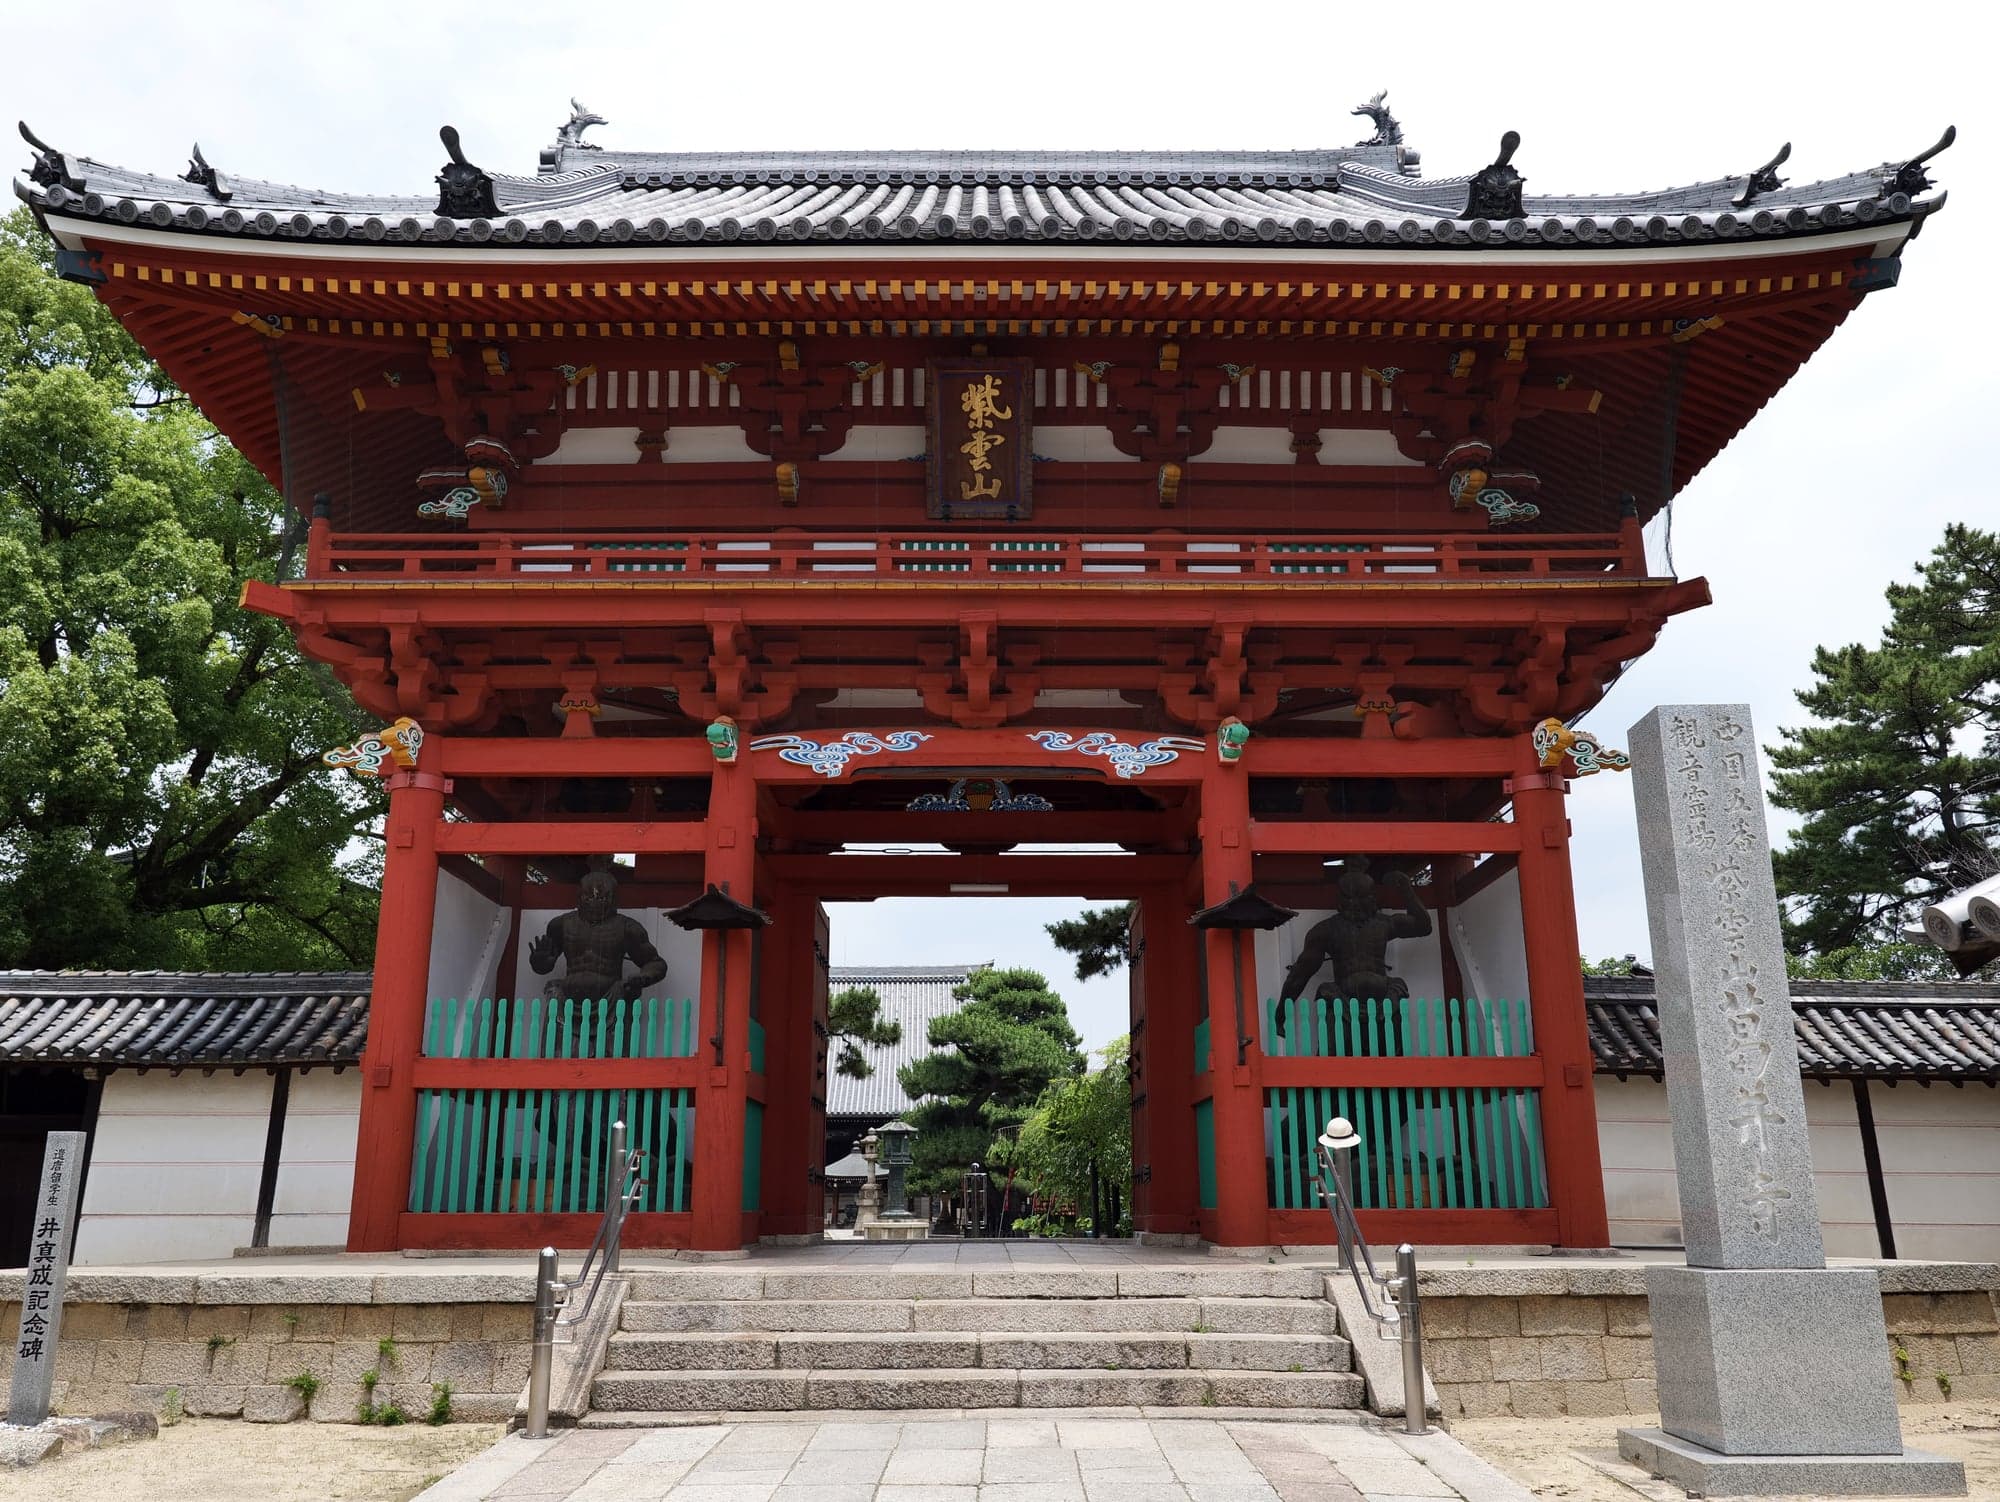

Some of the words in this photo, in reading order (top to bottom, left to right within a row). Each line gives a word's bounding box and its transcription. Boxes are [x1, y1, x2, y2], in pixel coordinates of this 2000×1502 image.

[960, 374, 1012, 500] 紫雲山
[47, 1148, 66, 1207] 遣唐留学生
[19, 1217, 61, 1362] 井真成記念碑
